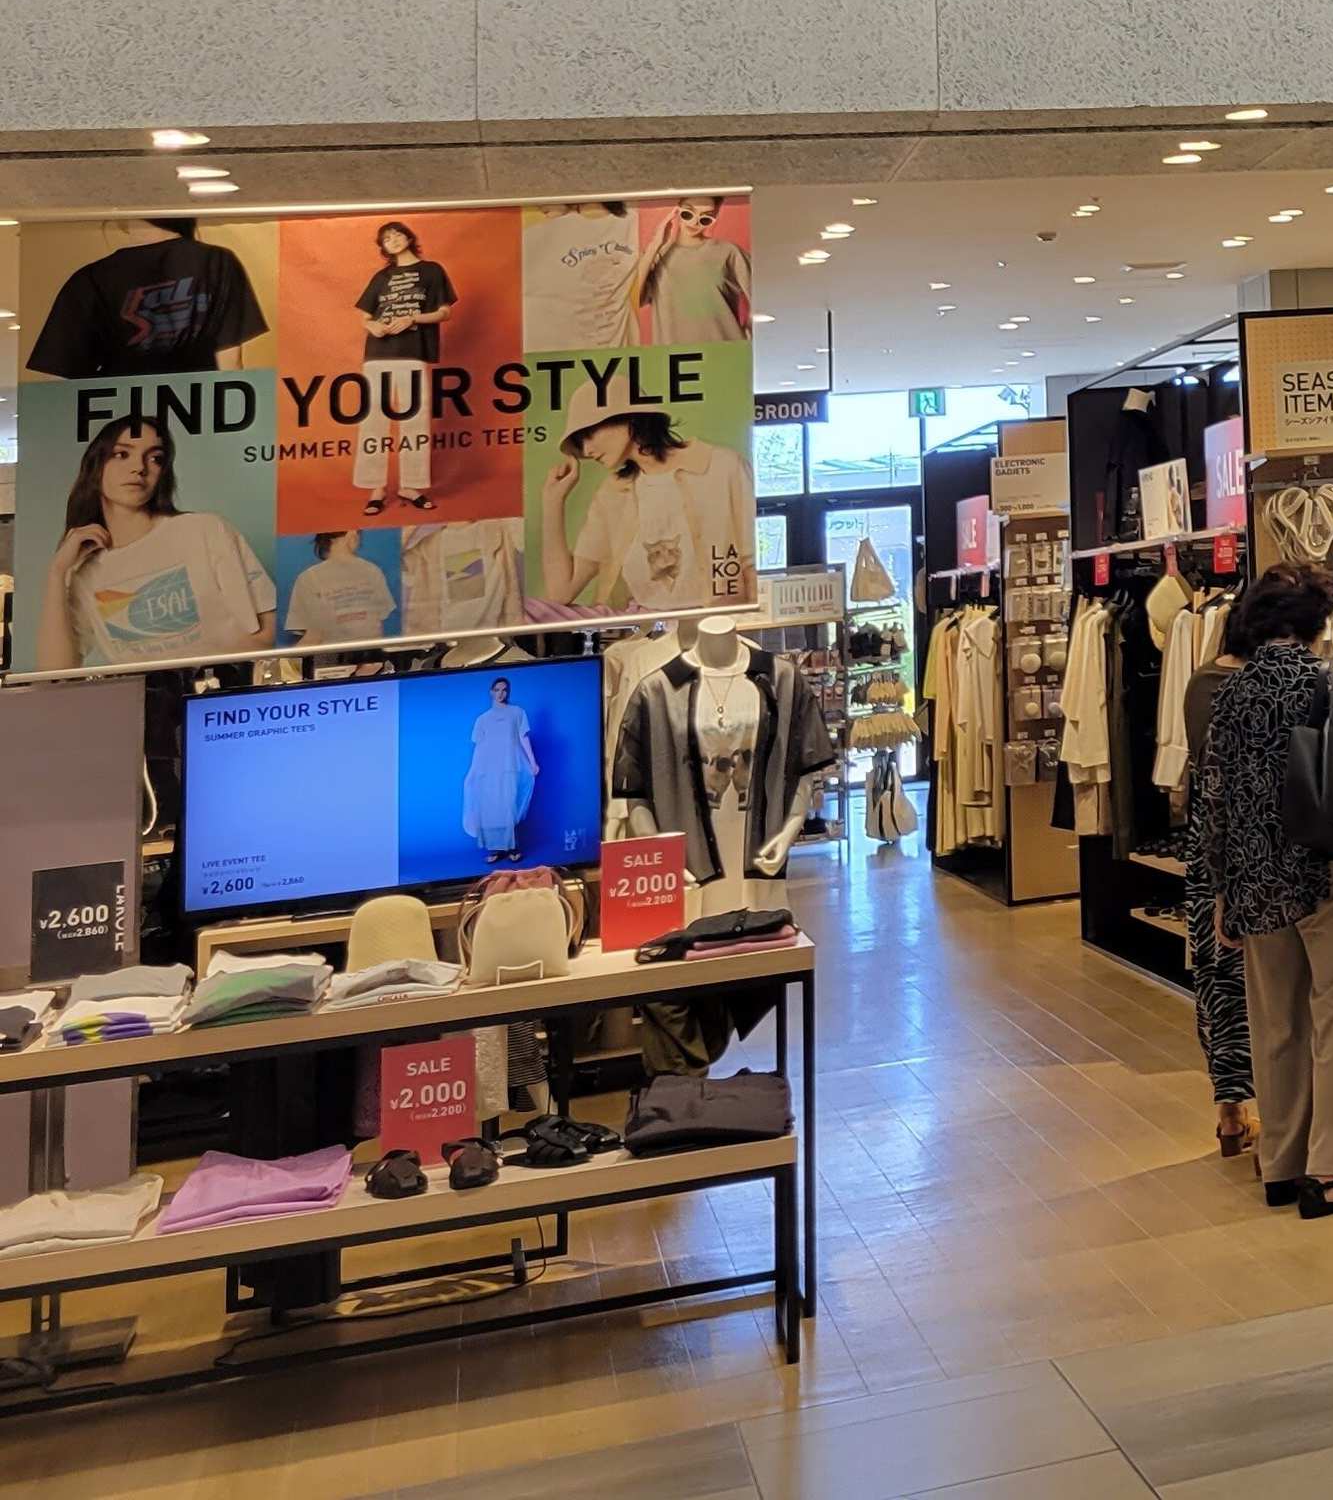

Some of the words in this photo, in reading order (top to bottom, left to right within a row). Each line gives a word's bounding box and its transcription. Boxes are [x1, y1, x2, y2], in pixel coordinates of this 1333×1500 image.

[75, 380, 258, 443] FIND
[281, 367, 473, 428] YOUR
[492, 352, 706, 415] STYLE
[243, 439, 353, 464] SUMMER
[362, 430, 474, 456] GRAPHIC
[483, 425, 547, 447] TEE'S
[995, 458, 1046, 468] ELECTRONIC
[1215, 449, 1243, 499] SALE
[711, 544, 738, 560] LA
[712, 561, 740, 578] KO
[712, 579, 739, 596] LE
[204, 708, 251, 727] FIND
[256, 703, 310, 721] YOUR
[317, 696, 379, 715] STYLE
[204, 731, 245, 742] SUMMER
[247, 727, 289, 739] GRAPHIC
[202, 860, 220, 869] LIVE
[222, 857, 249, 867] EVENT
[251, 855, 266, 863] TEE
[623, 852, 663, 869] SALE
[202, 877, 254, 895] ¥2,600
[407, 1057, 452, 1077] SALE
